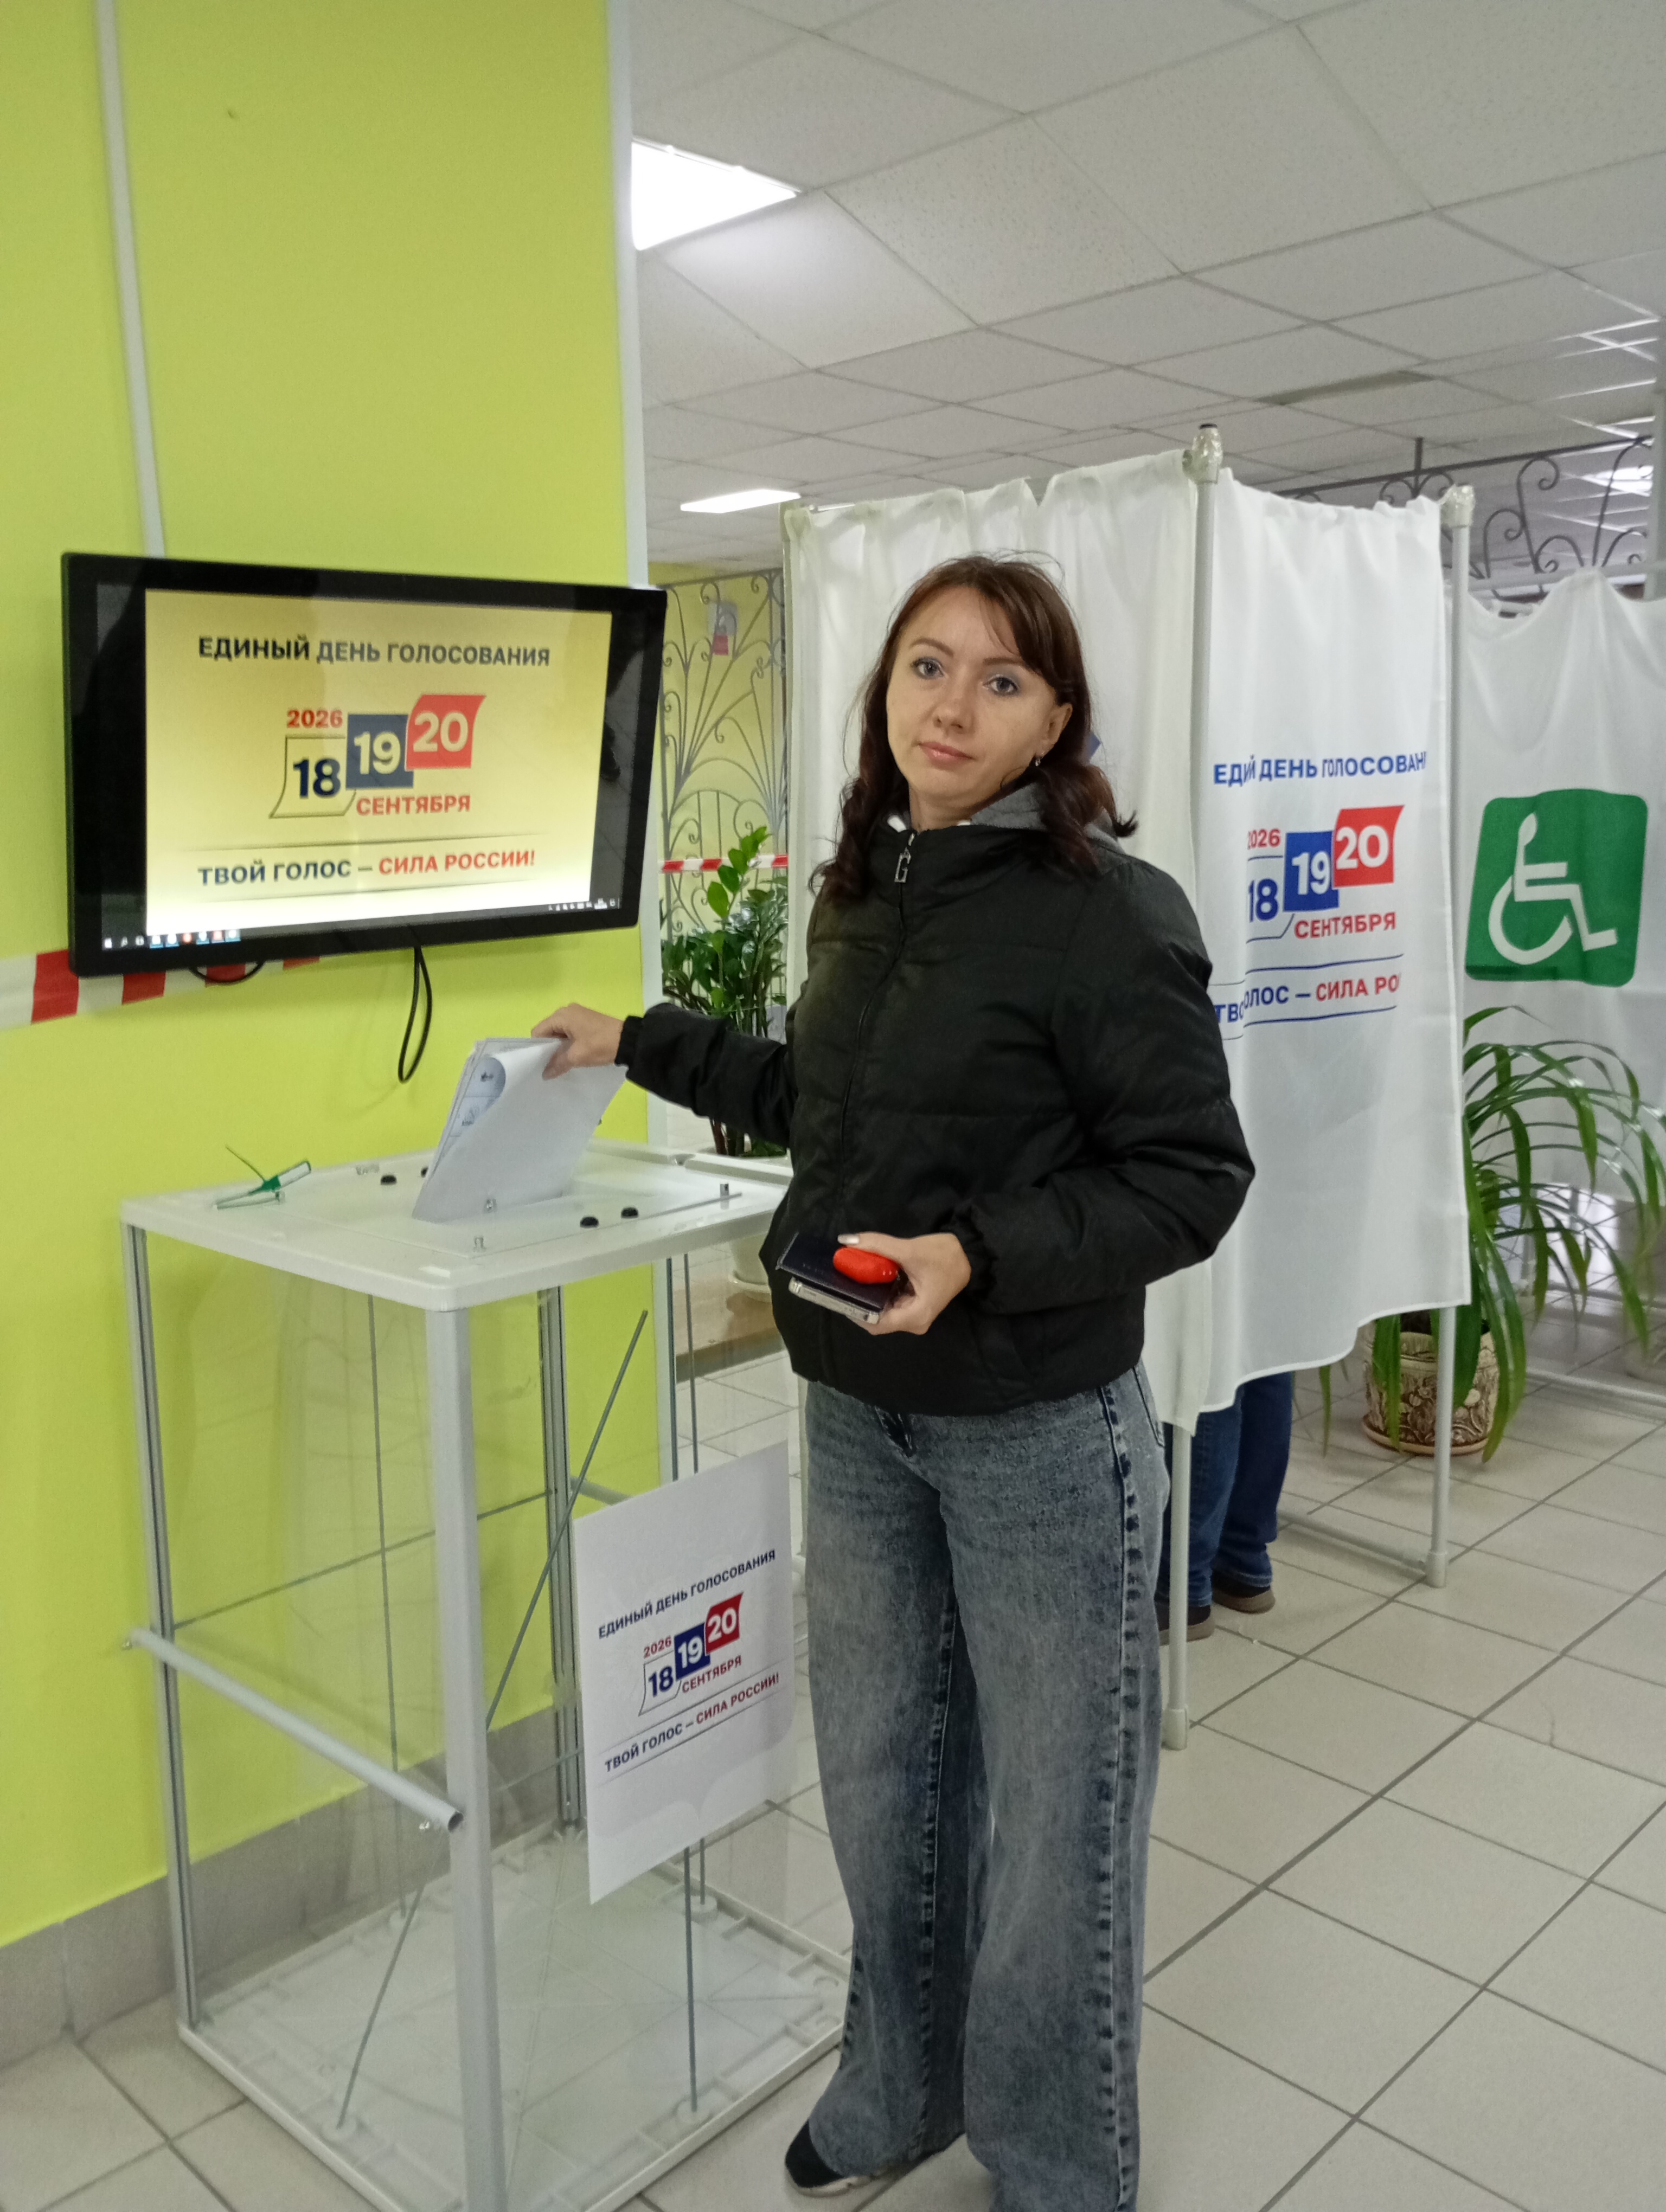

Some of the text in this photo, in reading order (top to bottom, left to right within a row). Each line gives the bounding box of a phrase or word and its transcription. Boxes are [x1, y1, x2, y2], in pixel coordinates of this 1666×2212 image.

[199, 634, 550, 666] ЕДИНЫЙ ДЕНЬ ГОЛОСОВАНИЯ
[287, 709, 343, 728] 2026
[413, 711, 469, 752] 20
[354, 731, 401, 774] 19
[1259, 758, 1317, 782] ДЕНЬ
[293, 758, 341, 799] 18
[356, 795, 470, 815] СЕНТЯБРЯ
[1336, 825, 1390, 870] 20
[198, 859, 265, 885] ТВОЙ
[274, 860, 351, 880] ГОЛОС
[380, 854, 438, 874] СИЛА
[445, 850, 535, 871] РОССИИ!
[1292, 851, 1330, 895] 19
[1248, 878, 1279, 922] 18
[1295, 912, 1396, 938] СЕНТЯБРЯ
[1244, 986, 1289, 1009] ОЛОС
[1316, 978, 1368, 1001] СИЛА
[599, 1549, 776, 1639] ЕДИНЫЙ ДЕНЬ ГОЛОСОВАНИЯ
[708, 1607, 736, 1643] 20
[644, 1636, 671, 1658] 2026
[678, 1637, 703, 1668] 19
[649, 1666, 674, 1697] 18
[682, 1656, 742, 1694] СЕНТЯБРЯ
[605, 1744, 639, 1772] ТВОЙ
[643, 1724, 682, 1753] ГОЛОС
[696, 1701, 728, 1725] СИЛА
[731, 1673, 779, 1707] РОССИИ!
